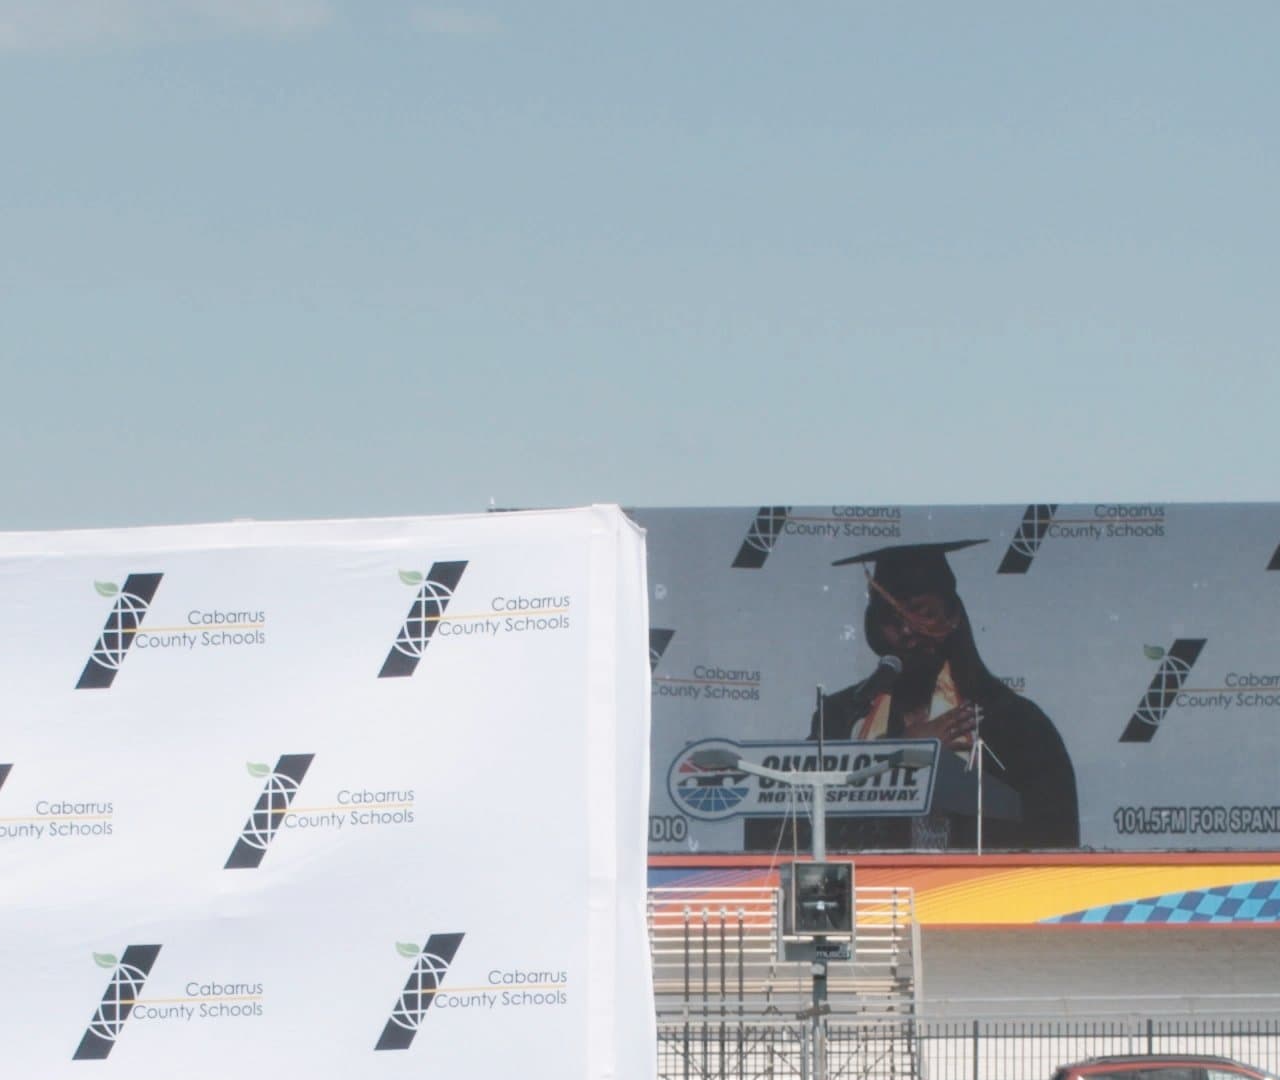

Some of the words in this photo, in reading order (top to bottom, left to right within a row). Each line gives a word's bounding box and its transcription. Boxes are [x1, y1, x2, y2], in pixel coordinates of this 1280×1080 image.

[1095, 504, 1165, 517] Cabarrus
[784, 522, 840, 537] County
[844, 524, 901, 538] Schools
[1049, 524, 1102, 540] County
[1106, 523, 1165, 537] Schools
[492, 596, 569, 611] Cabarrus
[188, 610, 264, 624] Cabarrus
[438, 617, 500, 636] County
[505, 615, 569, 632] Schools
[134, 630, 196, 649] County
[202, 630, 264, 646] Schools
[694, 665, 761, 681] Cabarrus
[704, 685, 760, 700] Schools
[1176, 694, 1233, 709] County
[338, 790, 414, 804] Cabarrus
[36, 801, 113, 815] Cabarrus
[283, 809, 345, 828] County
[351, 810, 413, 825] Schools
[1114, 806, 1186, 833] 101.5FM
[1189, 807, 1227, 833] FOR
[50, 822, 112, 836] Schools
[651, 817, 687, 841] DIO
[488, 970, 567, 984] Cabarrus
[186, 982, 263, 996] Cabarrus
[432, 989, 496, 1008] County
[502, 990, 566, 1005] Schools
[132, 1001, 194, 1020] County
[200, 1002, 262, 1017] Schools
